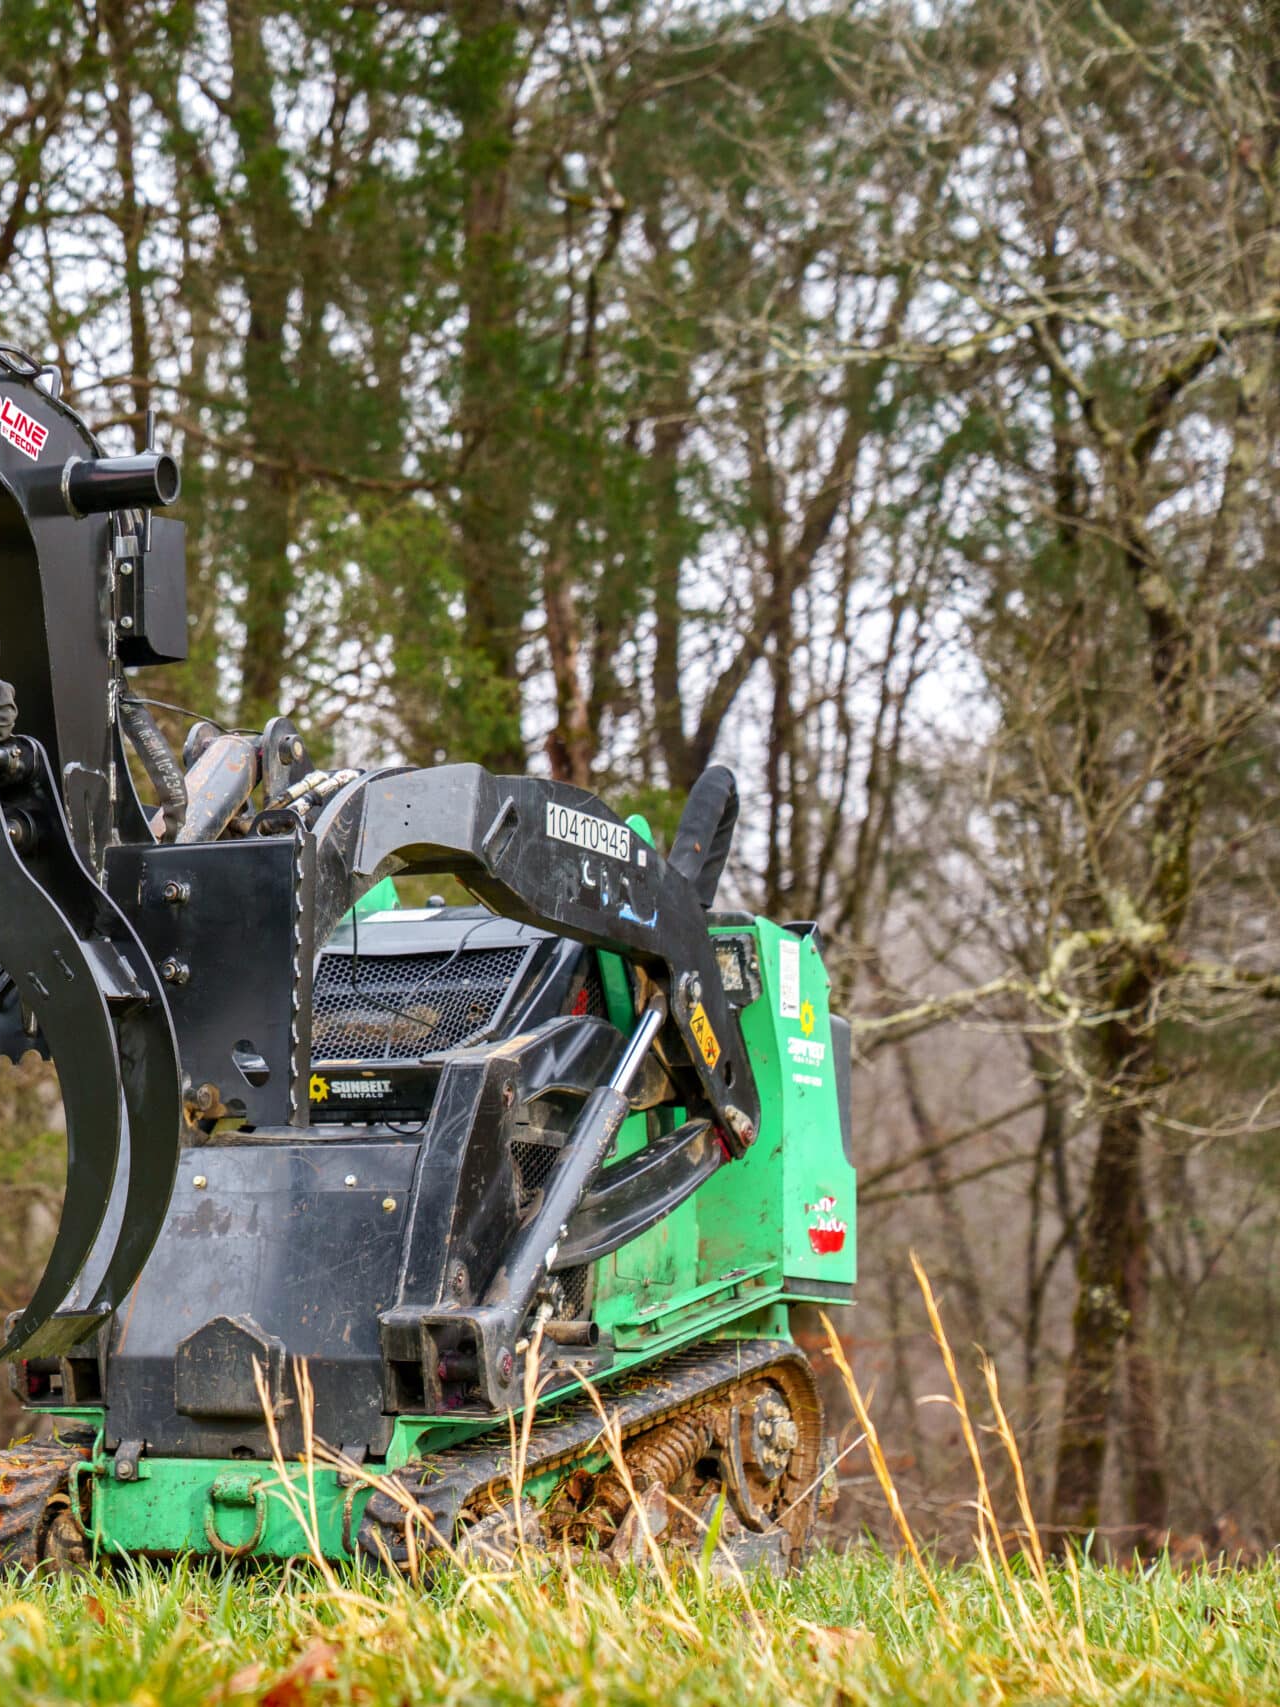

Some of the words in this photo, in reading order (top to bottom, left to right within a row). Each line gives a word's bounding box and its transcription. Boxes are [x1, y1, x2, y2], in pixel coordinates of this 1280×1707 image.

[9, 430, 37, 458] FECON
[549, 806, 628, 858] 10410945
[331, 1080, 391, 1093] SUNBELT
